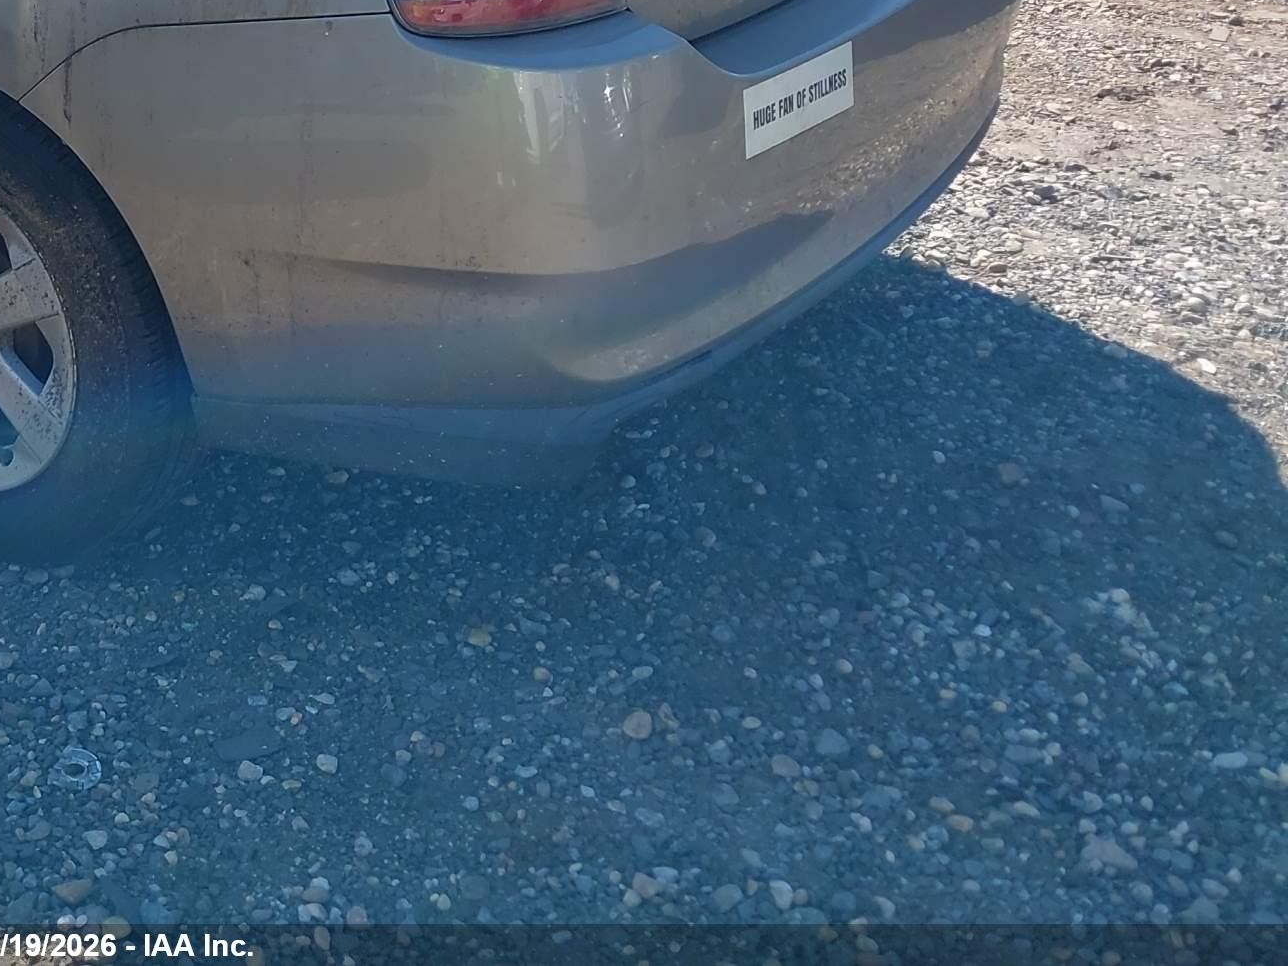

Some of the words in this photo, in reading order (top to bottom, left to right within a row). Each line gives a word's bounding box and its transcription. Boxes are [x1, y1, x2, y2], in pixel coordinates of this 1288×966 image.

[753, 102, 776, 130] HUGE
[778, 93, 794, 119] FAN
[796, 87, 806, 109] OF
[808, 68, 847, 103] STILLNESS
